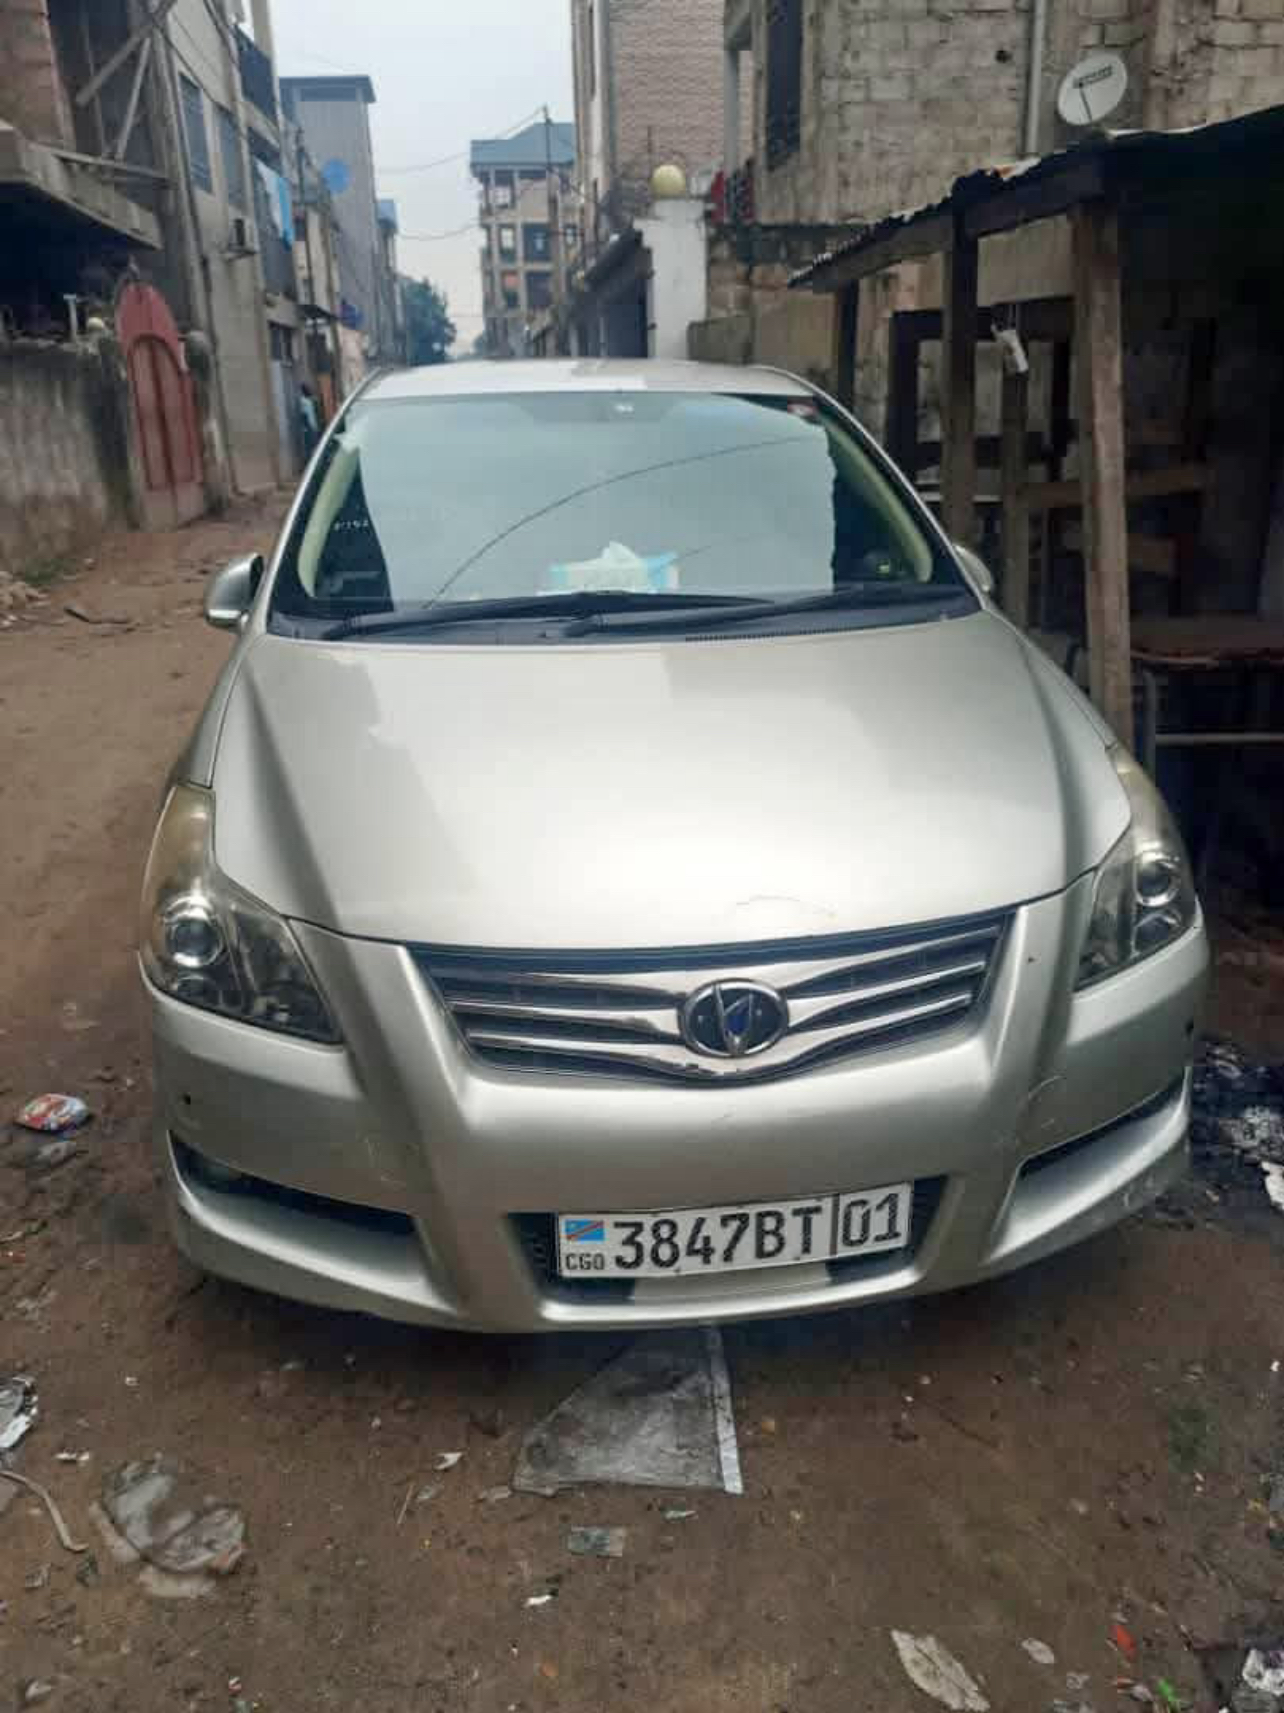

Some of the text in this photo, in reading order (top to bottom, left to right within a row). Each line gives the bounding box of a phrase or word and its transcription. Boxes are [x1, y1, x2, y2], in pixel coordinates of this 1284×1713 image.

[613, 1193, 902, 1270] 3847BT 01
[565, 1252, 605, 1271] CGO
